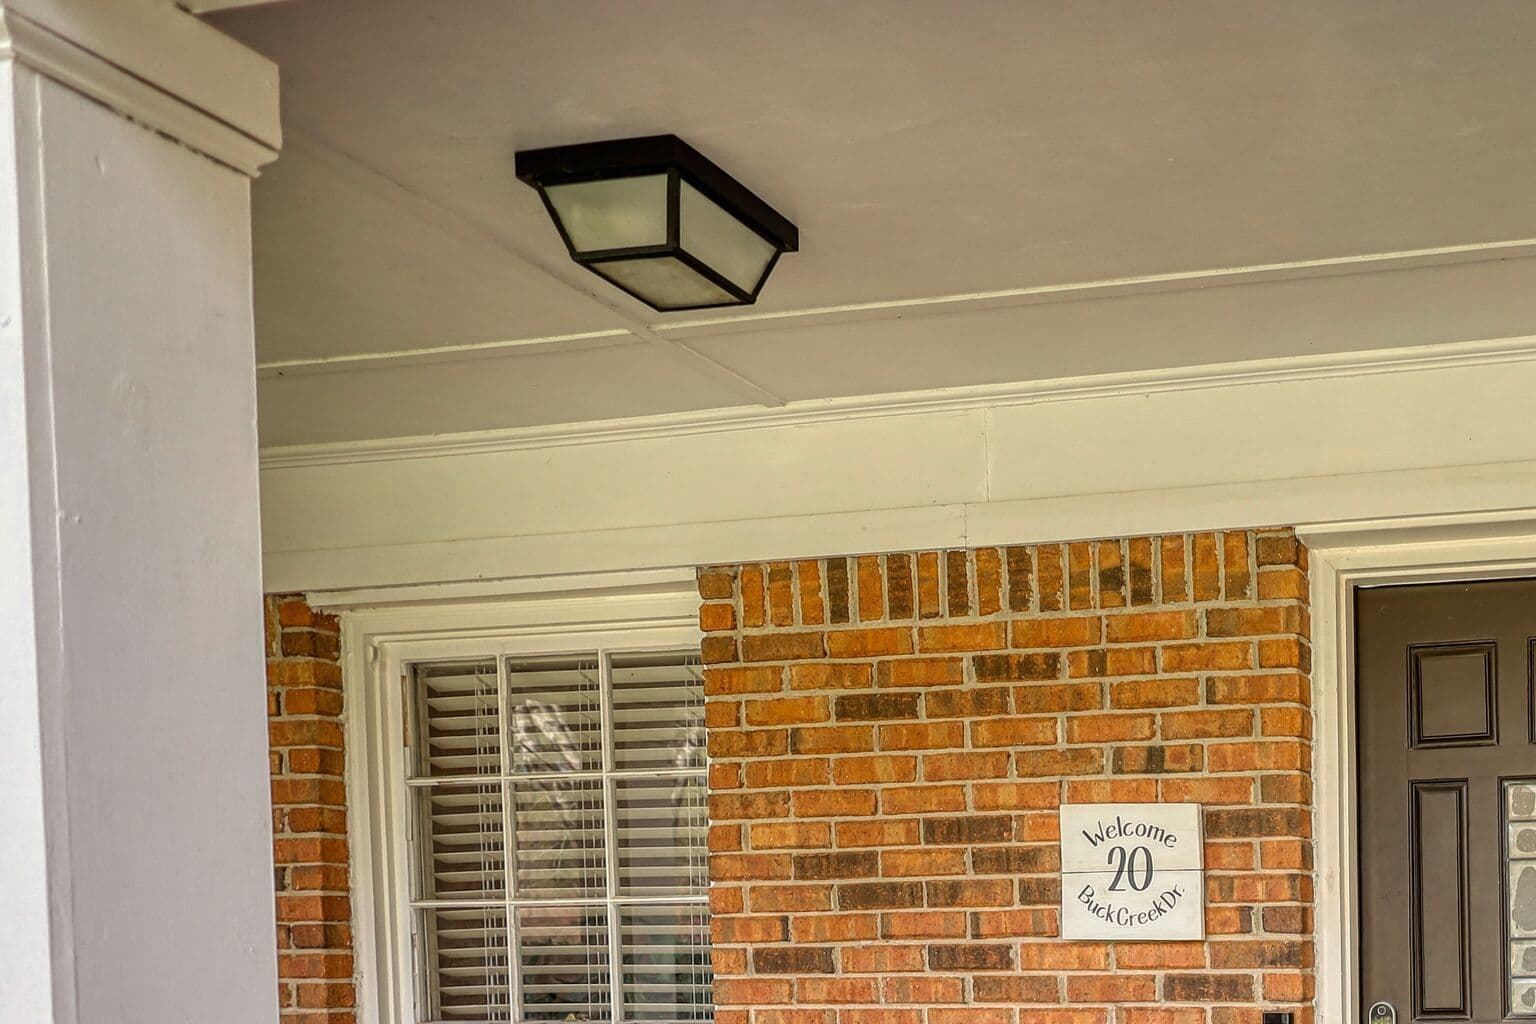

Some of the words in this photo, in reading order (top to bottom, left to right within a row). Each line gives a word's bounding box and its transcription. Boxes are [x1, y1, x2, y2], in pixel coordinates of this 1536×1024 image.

[1082, 816, 1177, 848] Welcome
[1107, 846, 1154, 892] 20
[1077, 884, 1114, 924] Buck
[1117, 900, 1168, 927] Creek
[1160, 884, 1185, 910] Dr.
